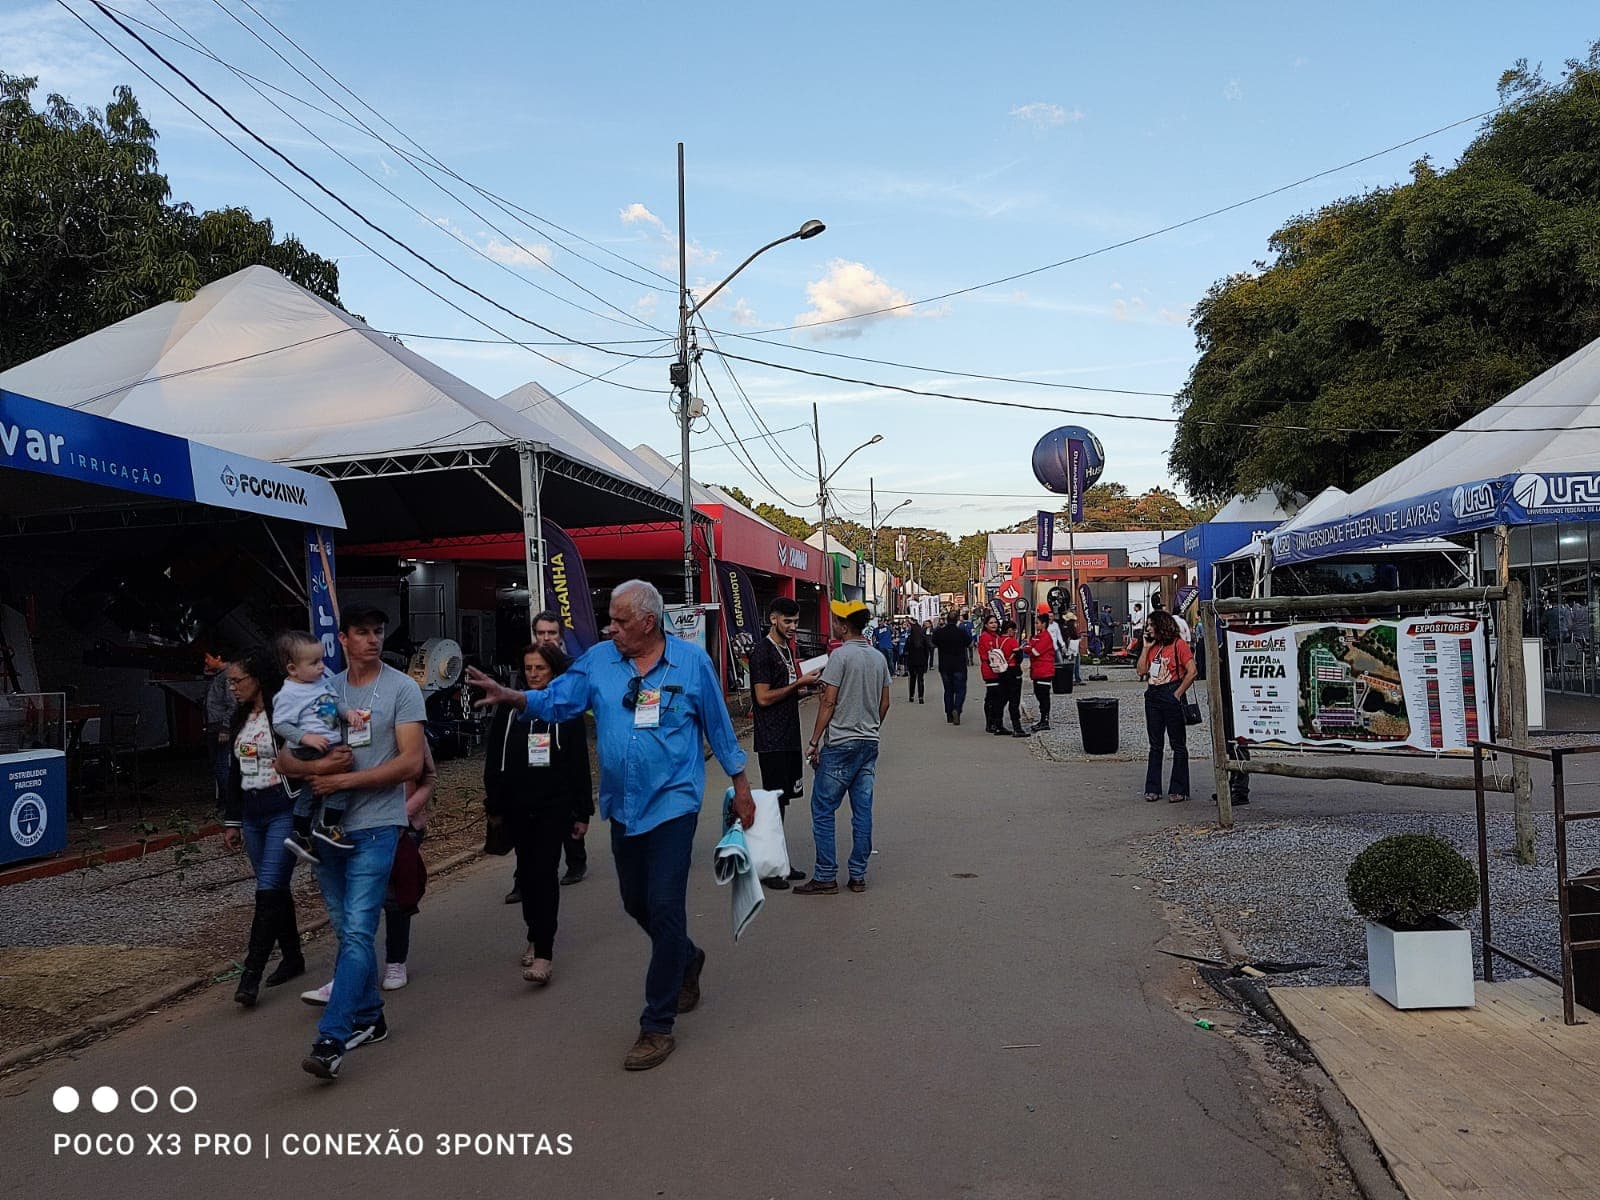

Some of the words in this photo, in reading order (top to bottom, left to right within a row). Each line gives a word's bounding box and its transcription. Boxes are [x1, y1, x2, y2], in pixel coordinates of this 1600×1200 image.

[69, 452, 162, 485] IRRIGAÇÃO
[239, 473, 308, 506] FOCKINK
[1296, 524, 1345, 551] UNIVERSIDADE
[1345, 516, 1383, 540] FEDERAL
[1384, 511, 1399, 532] DE
[1399, 501, 1441, 529] LAVRAS
[1072, 558, 1105, 567] antander
[550, 552, 575, 630] ARANHA
[729, 571, 745, 627] GAFANHOTO
[1415, 623, 1470, 633] EXPOSITORES
[1242, 655, 1272, 665] MAPA
[1240, 665, 1286, 679] FEIRA
[9, 768, 47, 781] DISTRIBUIDOR
